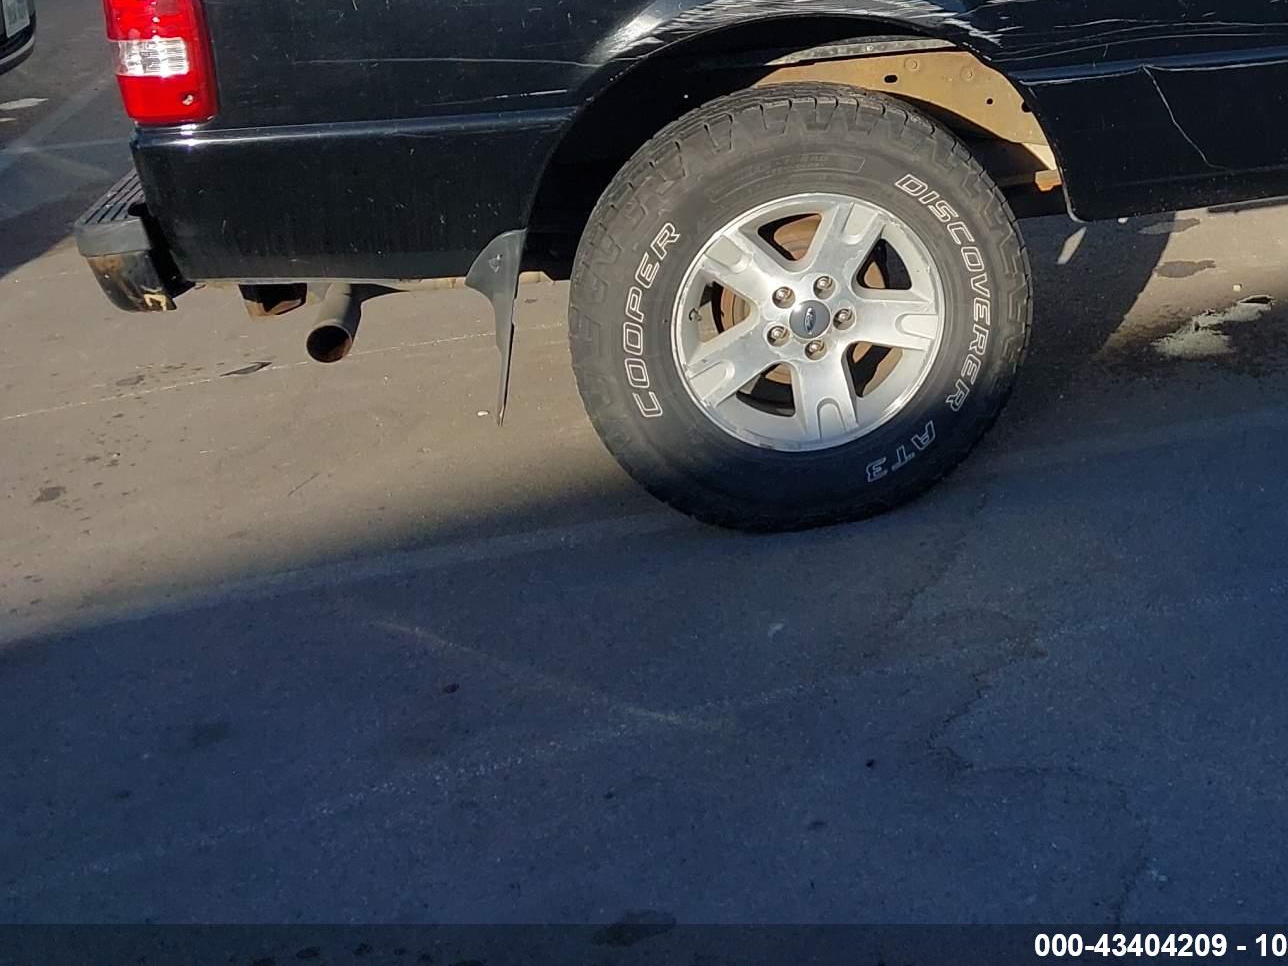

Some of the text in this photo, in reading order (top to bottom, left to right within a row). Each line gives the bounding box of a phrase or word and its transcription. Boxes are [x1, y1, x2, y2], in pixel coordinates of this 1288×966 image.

[623, 173, 992, 482] COOPER DISCOVERER AT3
